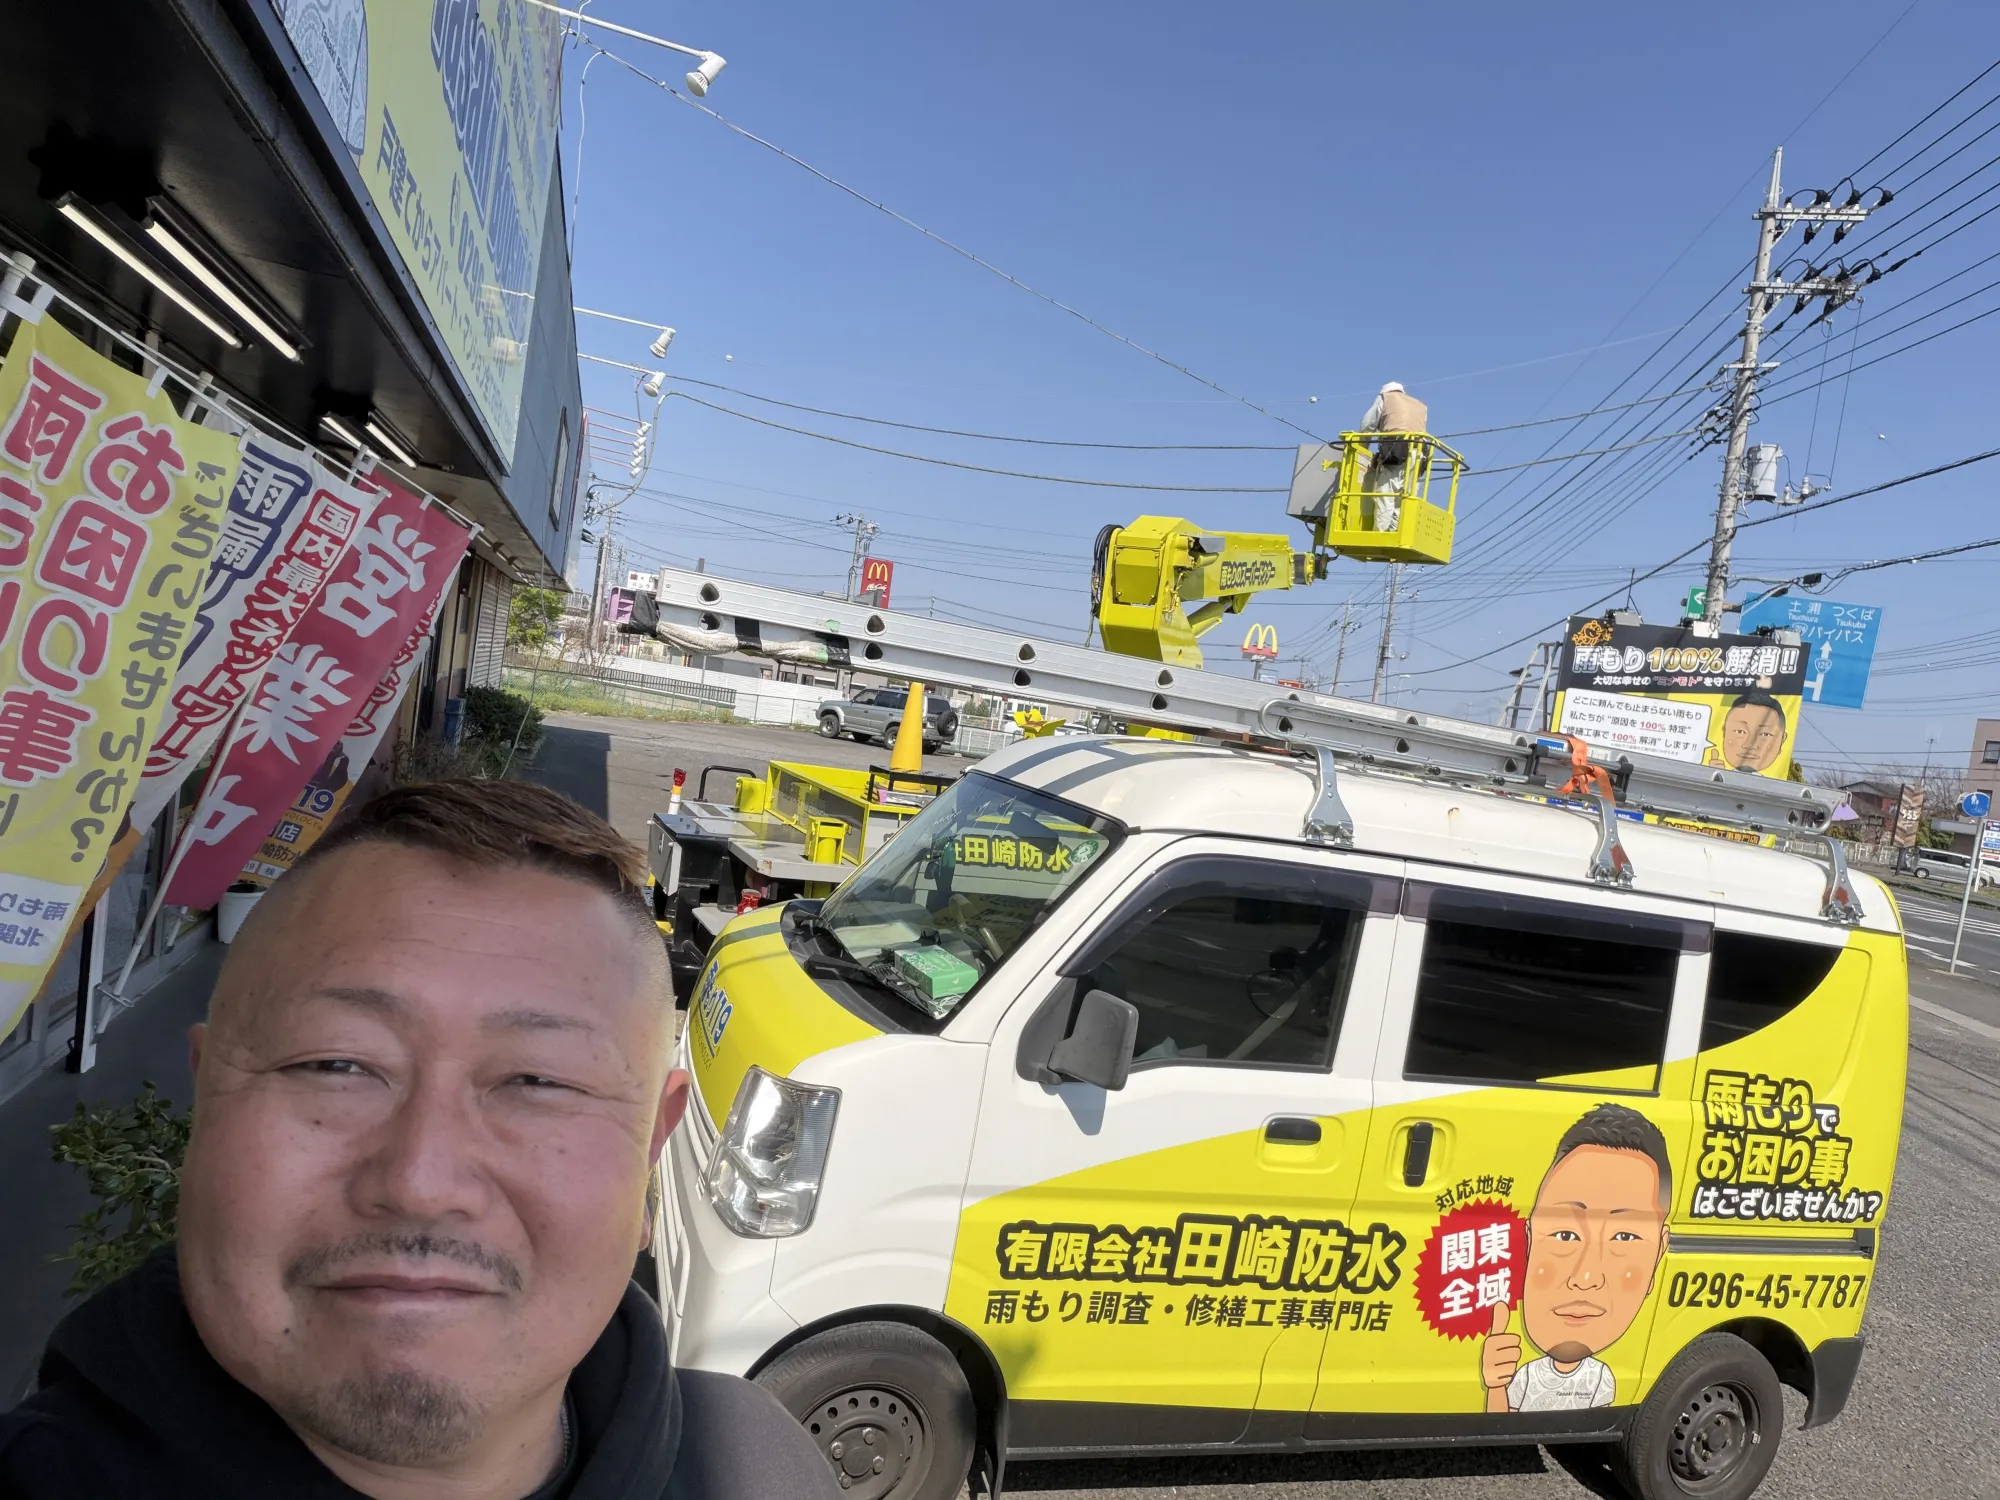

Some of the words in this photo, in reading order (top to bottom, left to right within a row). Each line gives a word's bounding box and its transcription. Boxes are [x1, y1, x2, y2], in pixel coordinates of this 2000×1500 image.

[1832, 605, 1876, 621] つくば
[1836, 618, 1867, 629] Tsukuba
[1807, 626, 1864, 643] バイパス
[1704, 1071, 1839, 1135] 雨もりで
[1698, 1132, 1850, 1188] お困り事
[1435, 1174, 1515, 1212] 対応地域
[1693, 1186, 1881, 1221] はございませんか?
[1001, 1219, 1403, 1291] 有限会社田崎防水
[1440, 1222, 1512, 1275] 関東
[1438, 1267, 1512, 1321] 全域
[1668, 1271, 1867, 1309] 0296-45-7787
[984, 1289, 1393, 1332] 雨もり調査・修繕工事専門店
